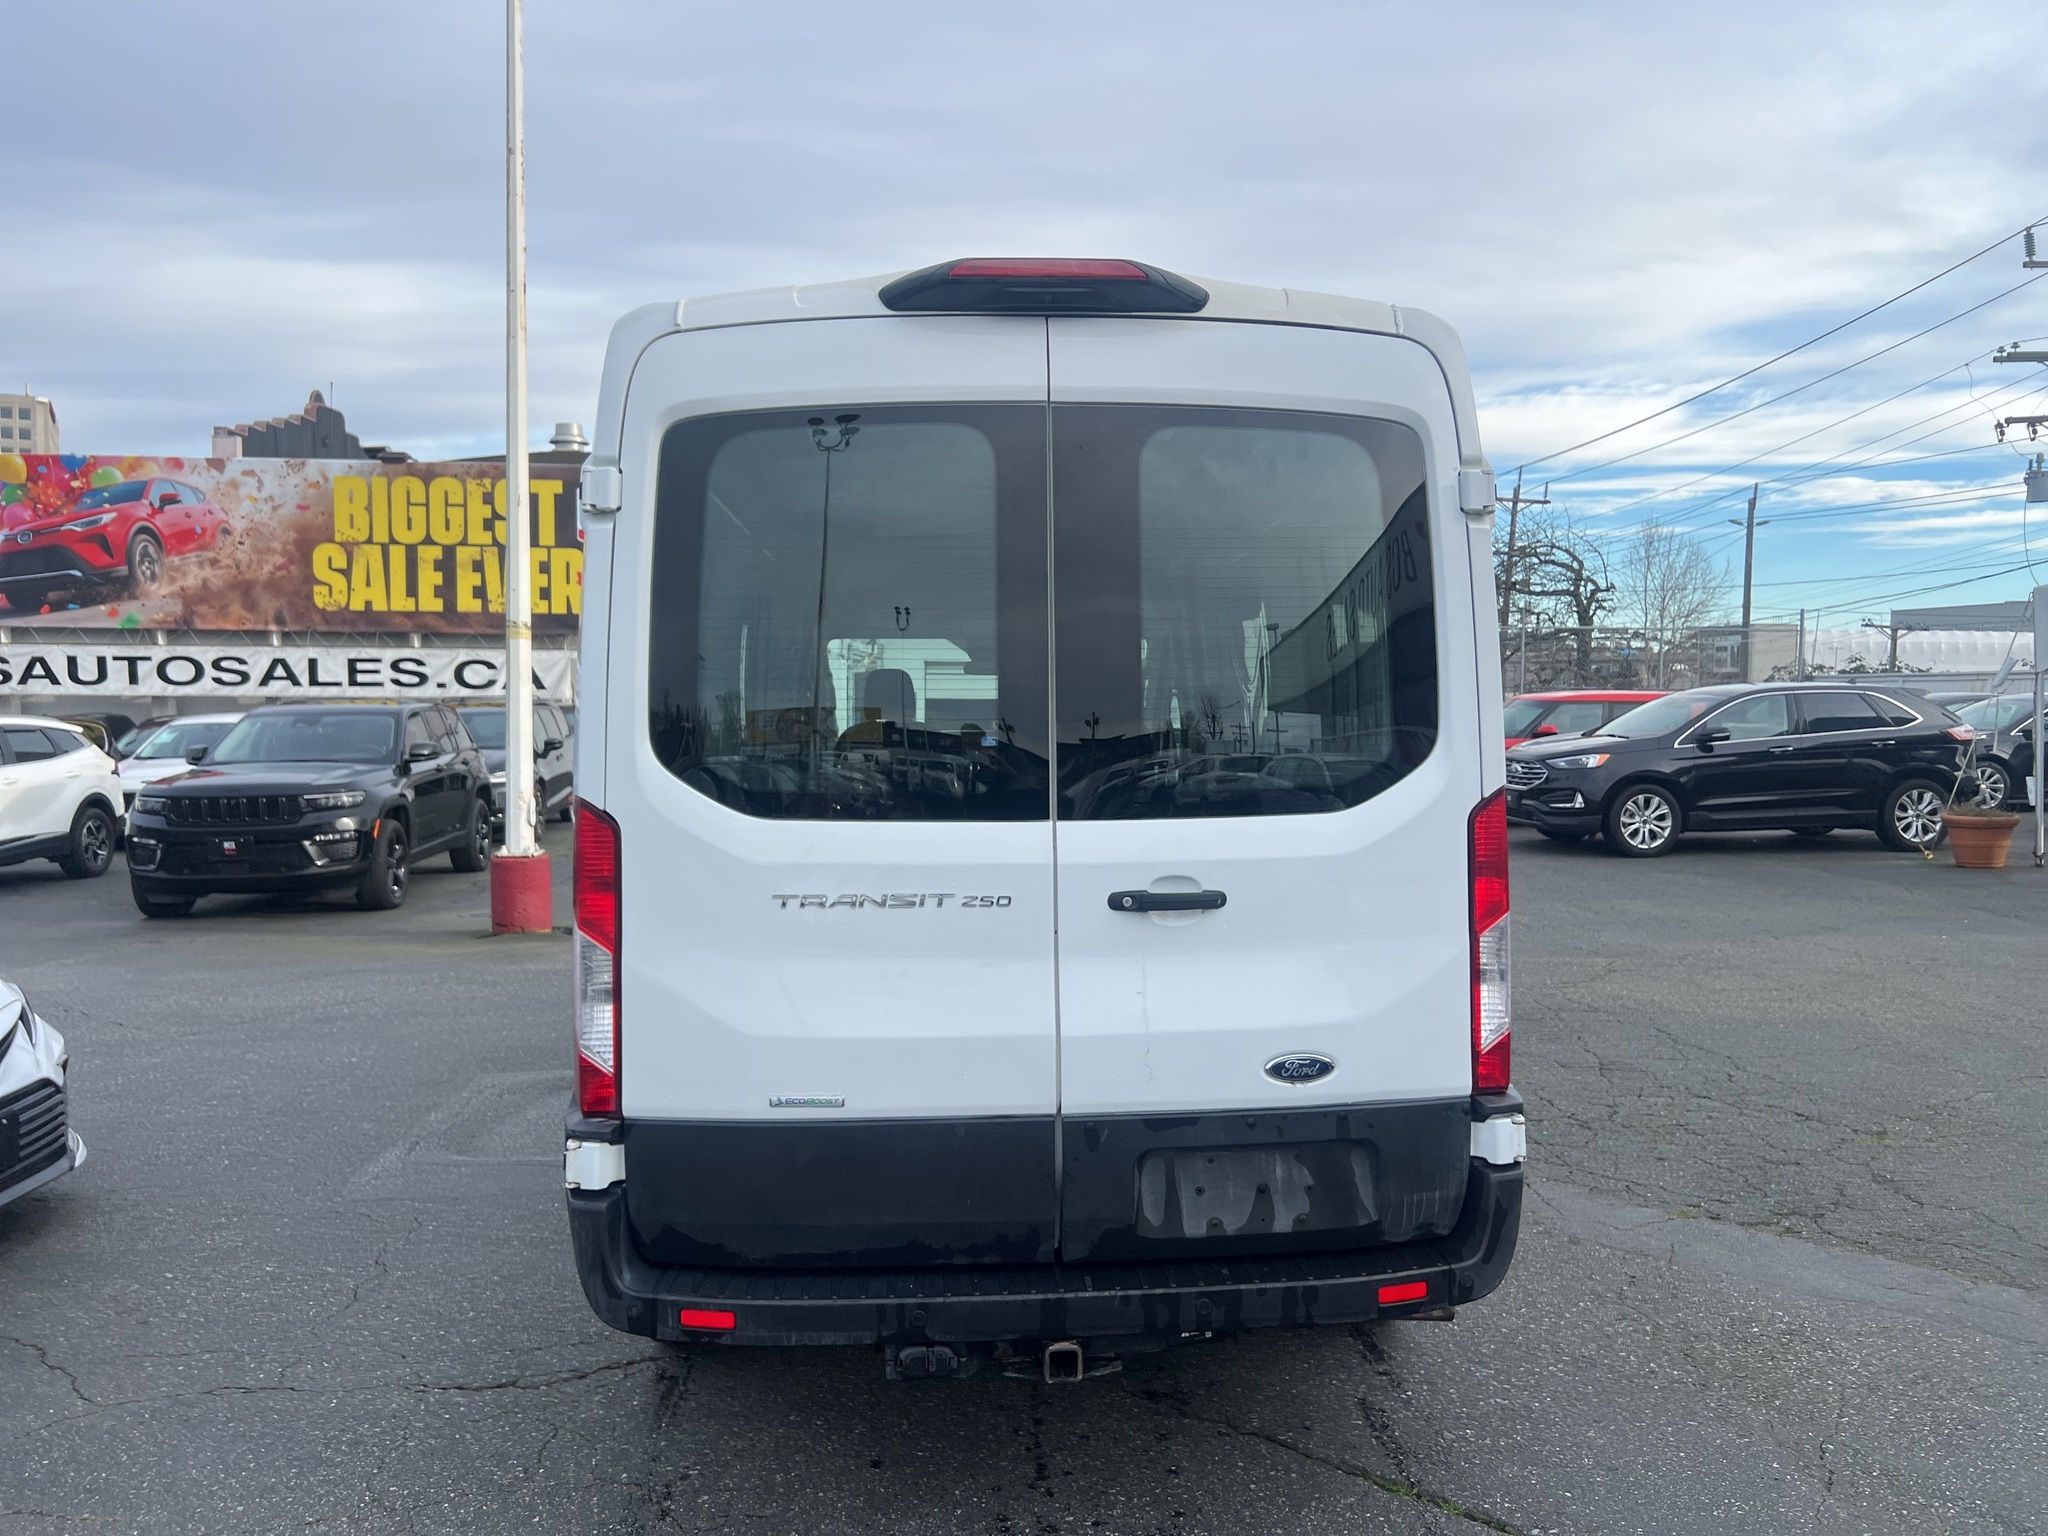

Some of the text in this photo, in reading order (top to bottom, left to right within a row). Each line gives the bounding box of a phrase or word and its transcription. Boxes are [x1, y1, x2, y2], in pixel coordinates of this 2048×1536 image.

[312, 542, 443, 612] SALE
[771, 893, 1012, 909] TRANSIT 250
[1281, 1059, 1320, 1077] Ford
